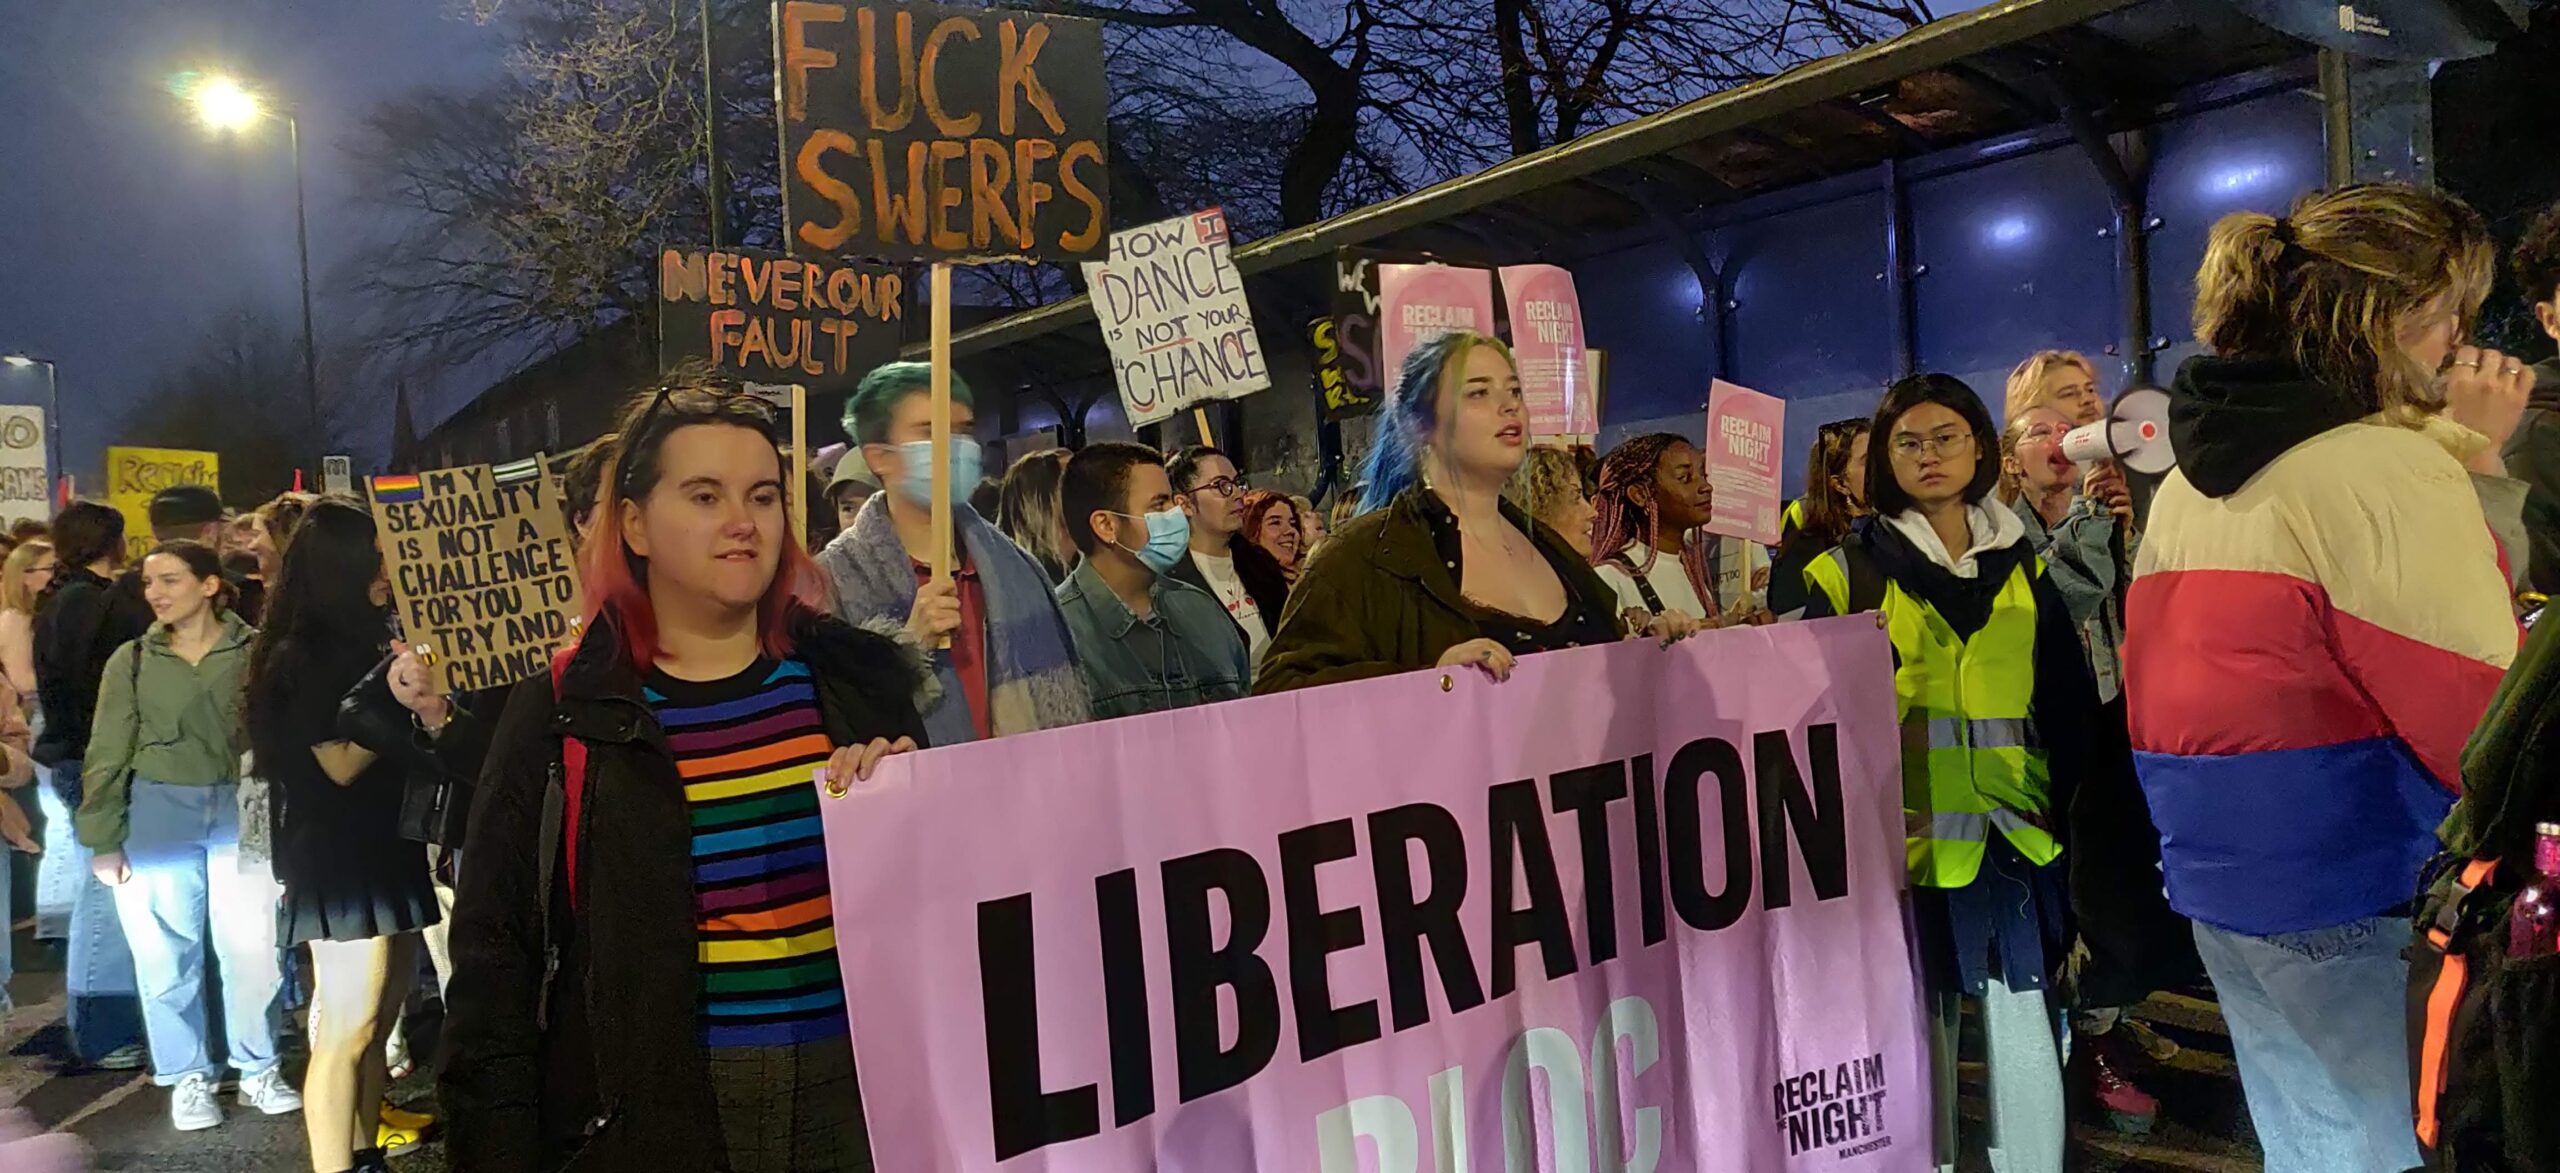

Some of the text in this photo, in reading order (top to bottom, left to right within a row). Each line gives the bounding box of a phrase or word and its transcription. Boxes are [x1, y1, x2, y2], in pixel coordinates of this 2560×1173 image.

[784, 1, 1066, 137] FUCK
[797, 128, 1104, 251] SWERFS
[1199, 214, 1226, 242] I
[662, 250, 902, 321] NEVER OUR
[1099, 242, 1240, 325] DANCE
[1107, 303, 1246, 349] IS NOT YOUR
[1402, 303, 1475, 328] RECLAIM
[1525, 300, 1573, 322] RECLAIM
[1537, 320, 1575, 344] NIGHT
[710, 309, 859, 375] FAULT
[1720, 414, 1773, 444] RECLAIM
[1728, 434, 1771, 464] NIGHT
[385, 481, 541, 533] SEXUALITY
[429, 467, 482, 496] MY
[397, 518, 539, 561] IS NOT A
[399, 537, 570, 598] CHALLENGE
[409, 574, 573, 629] FOR YOU TO
[432, 609, 567, 657] TRY AND
[976, 723, 1849, 1162] LIBERATION
[1773, 1053, 1886, 1120] RECLAIM
[1788, 1089, 1887, 1157] NIGHT
